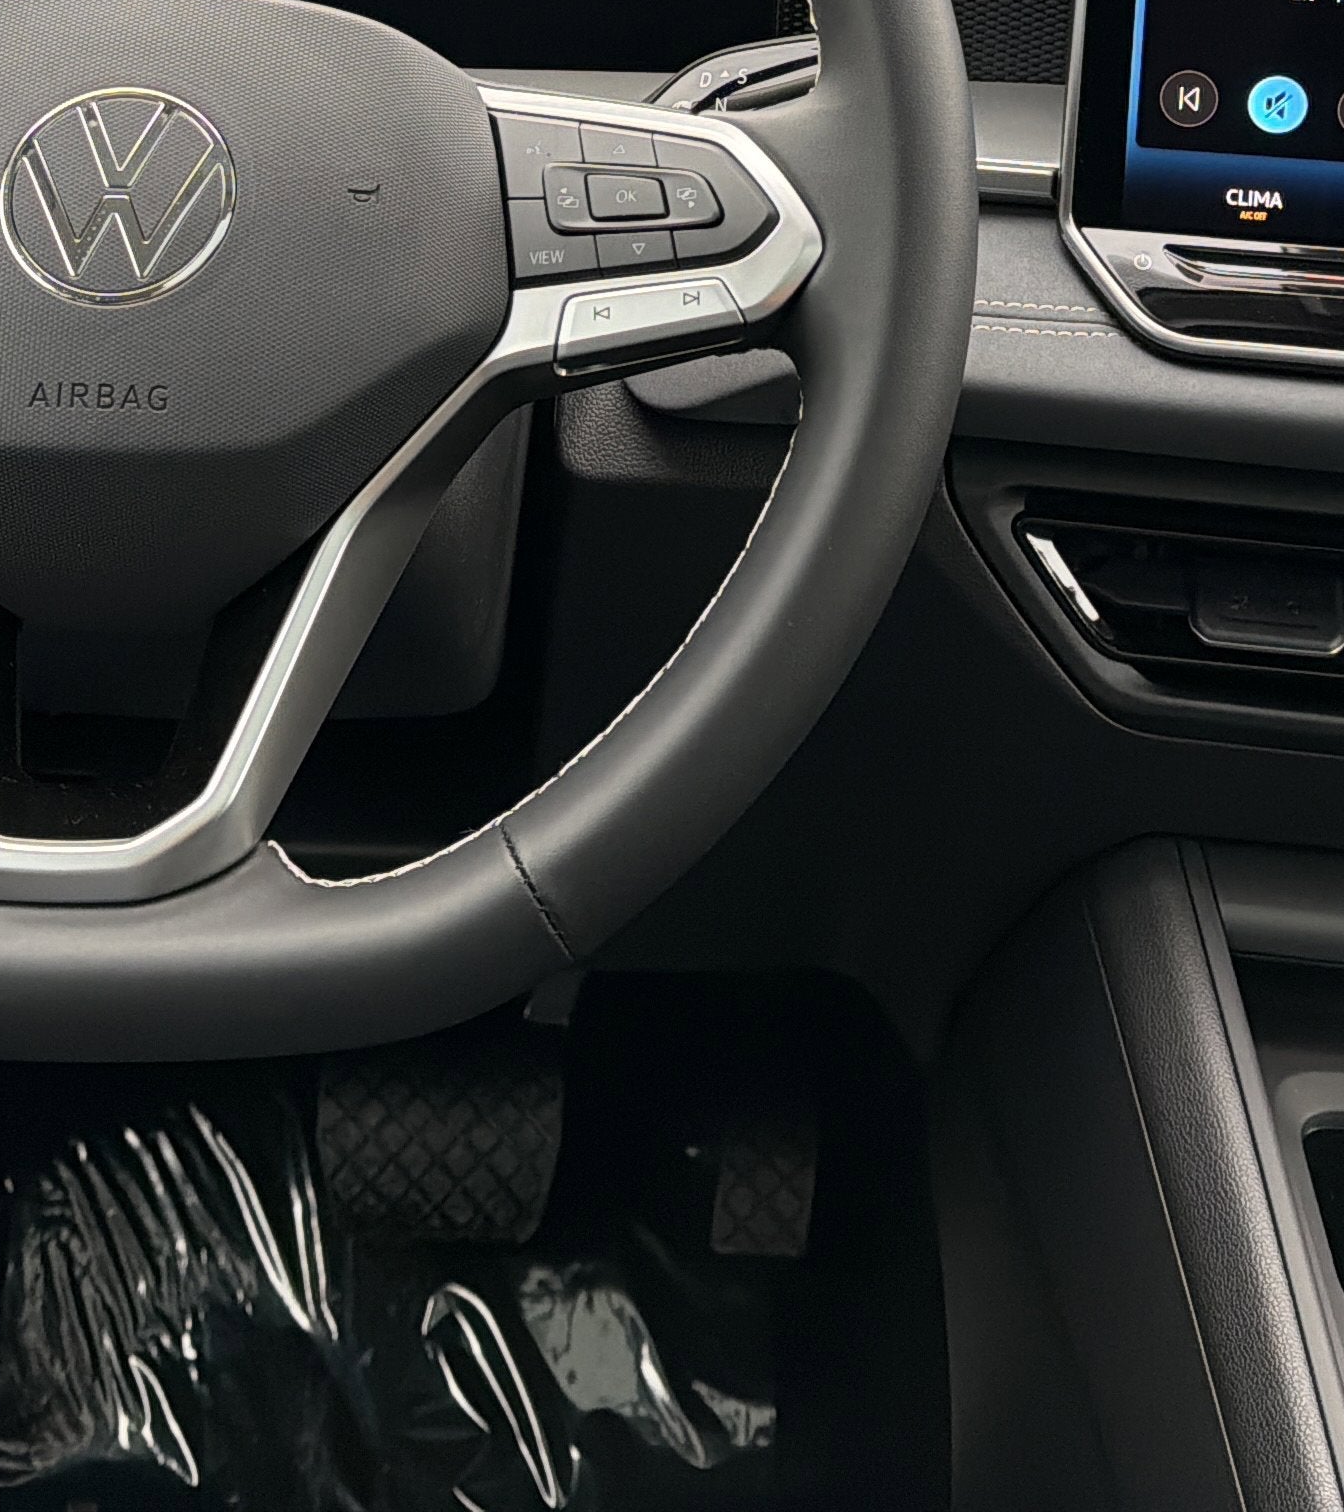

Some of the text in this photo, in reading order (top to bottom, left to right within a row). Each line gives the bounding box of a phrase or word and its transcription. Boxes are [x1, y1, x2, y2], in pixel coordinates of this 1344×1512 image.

[699, 71, 712, 88] D
[737, 68, 749, 85] S
[615, 188, 638, 204] OK
[1225, 188, 1284, 210] CLIMA
[529, 250, 565, 265] VIEW
[27, 381, 171, 412] AIRBAG
